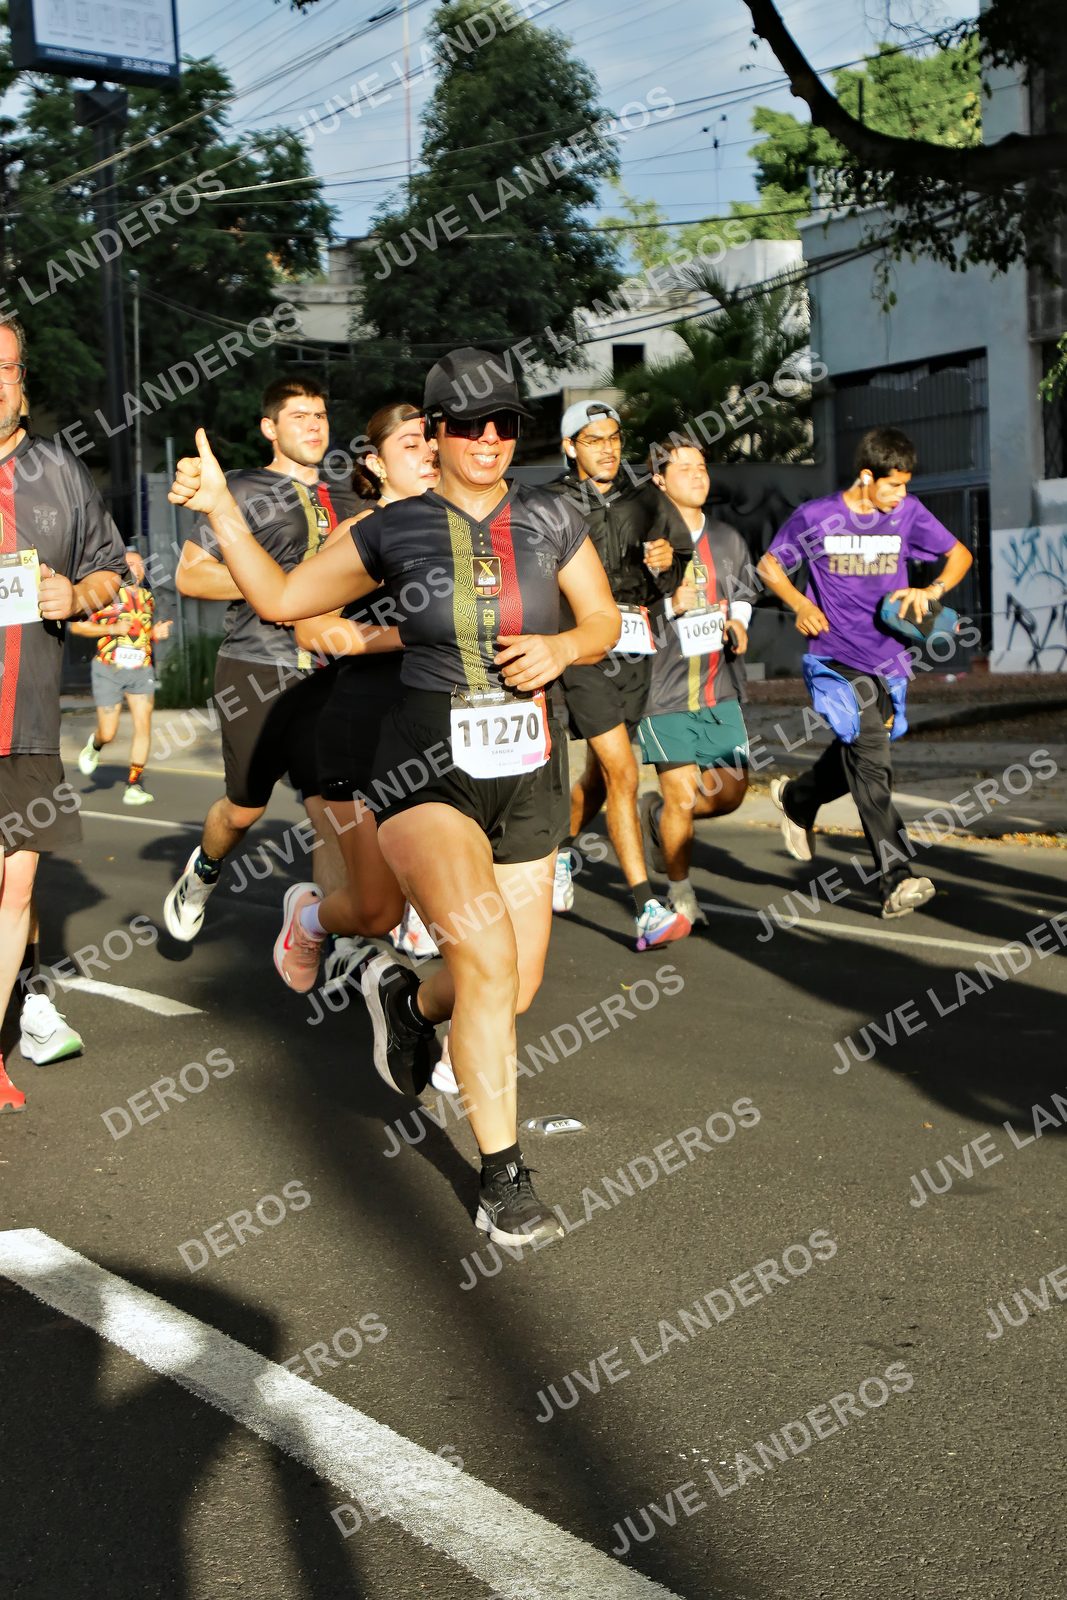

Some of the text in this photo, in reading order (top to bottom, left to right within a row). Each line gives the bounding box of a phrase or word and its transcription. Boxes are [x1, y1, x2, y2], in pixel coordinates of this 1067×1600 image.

[828, 554, 899, 577] TENNIS
[683, 617, 725, 640] 10690
[458, 712, 540, 748] 11270
